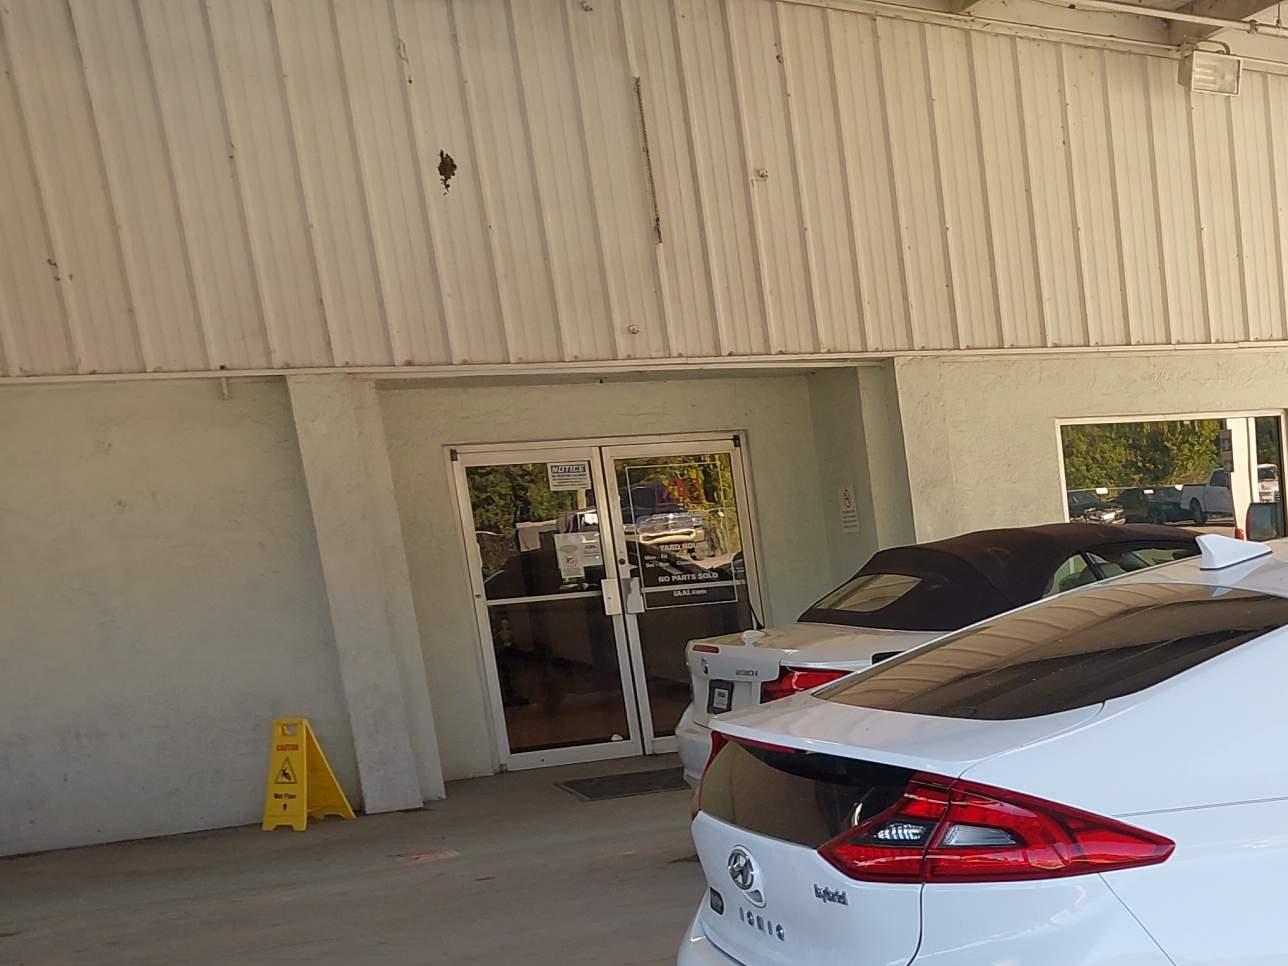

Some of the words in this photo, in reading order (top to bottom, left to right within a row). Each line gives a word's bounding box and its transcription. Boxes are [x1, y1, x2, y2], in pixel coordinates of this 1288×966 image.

[551, 464, 586, 473] NOTICE
[672, 573, 696, 582] PARTS
[697, 572, 718, 580] SOLD
[739, 906, 785, 941] IONIQ
